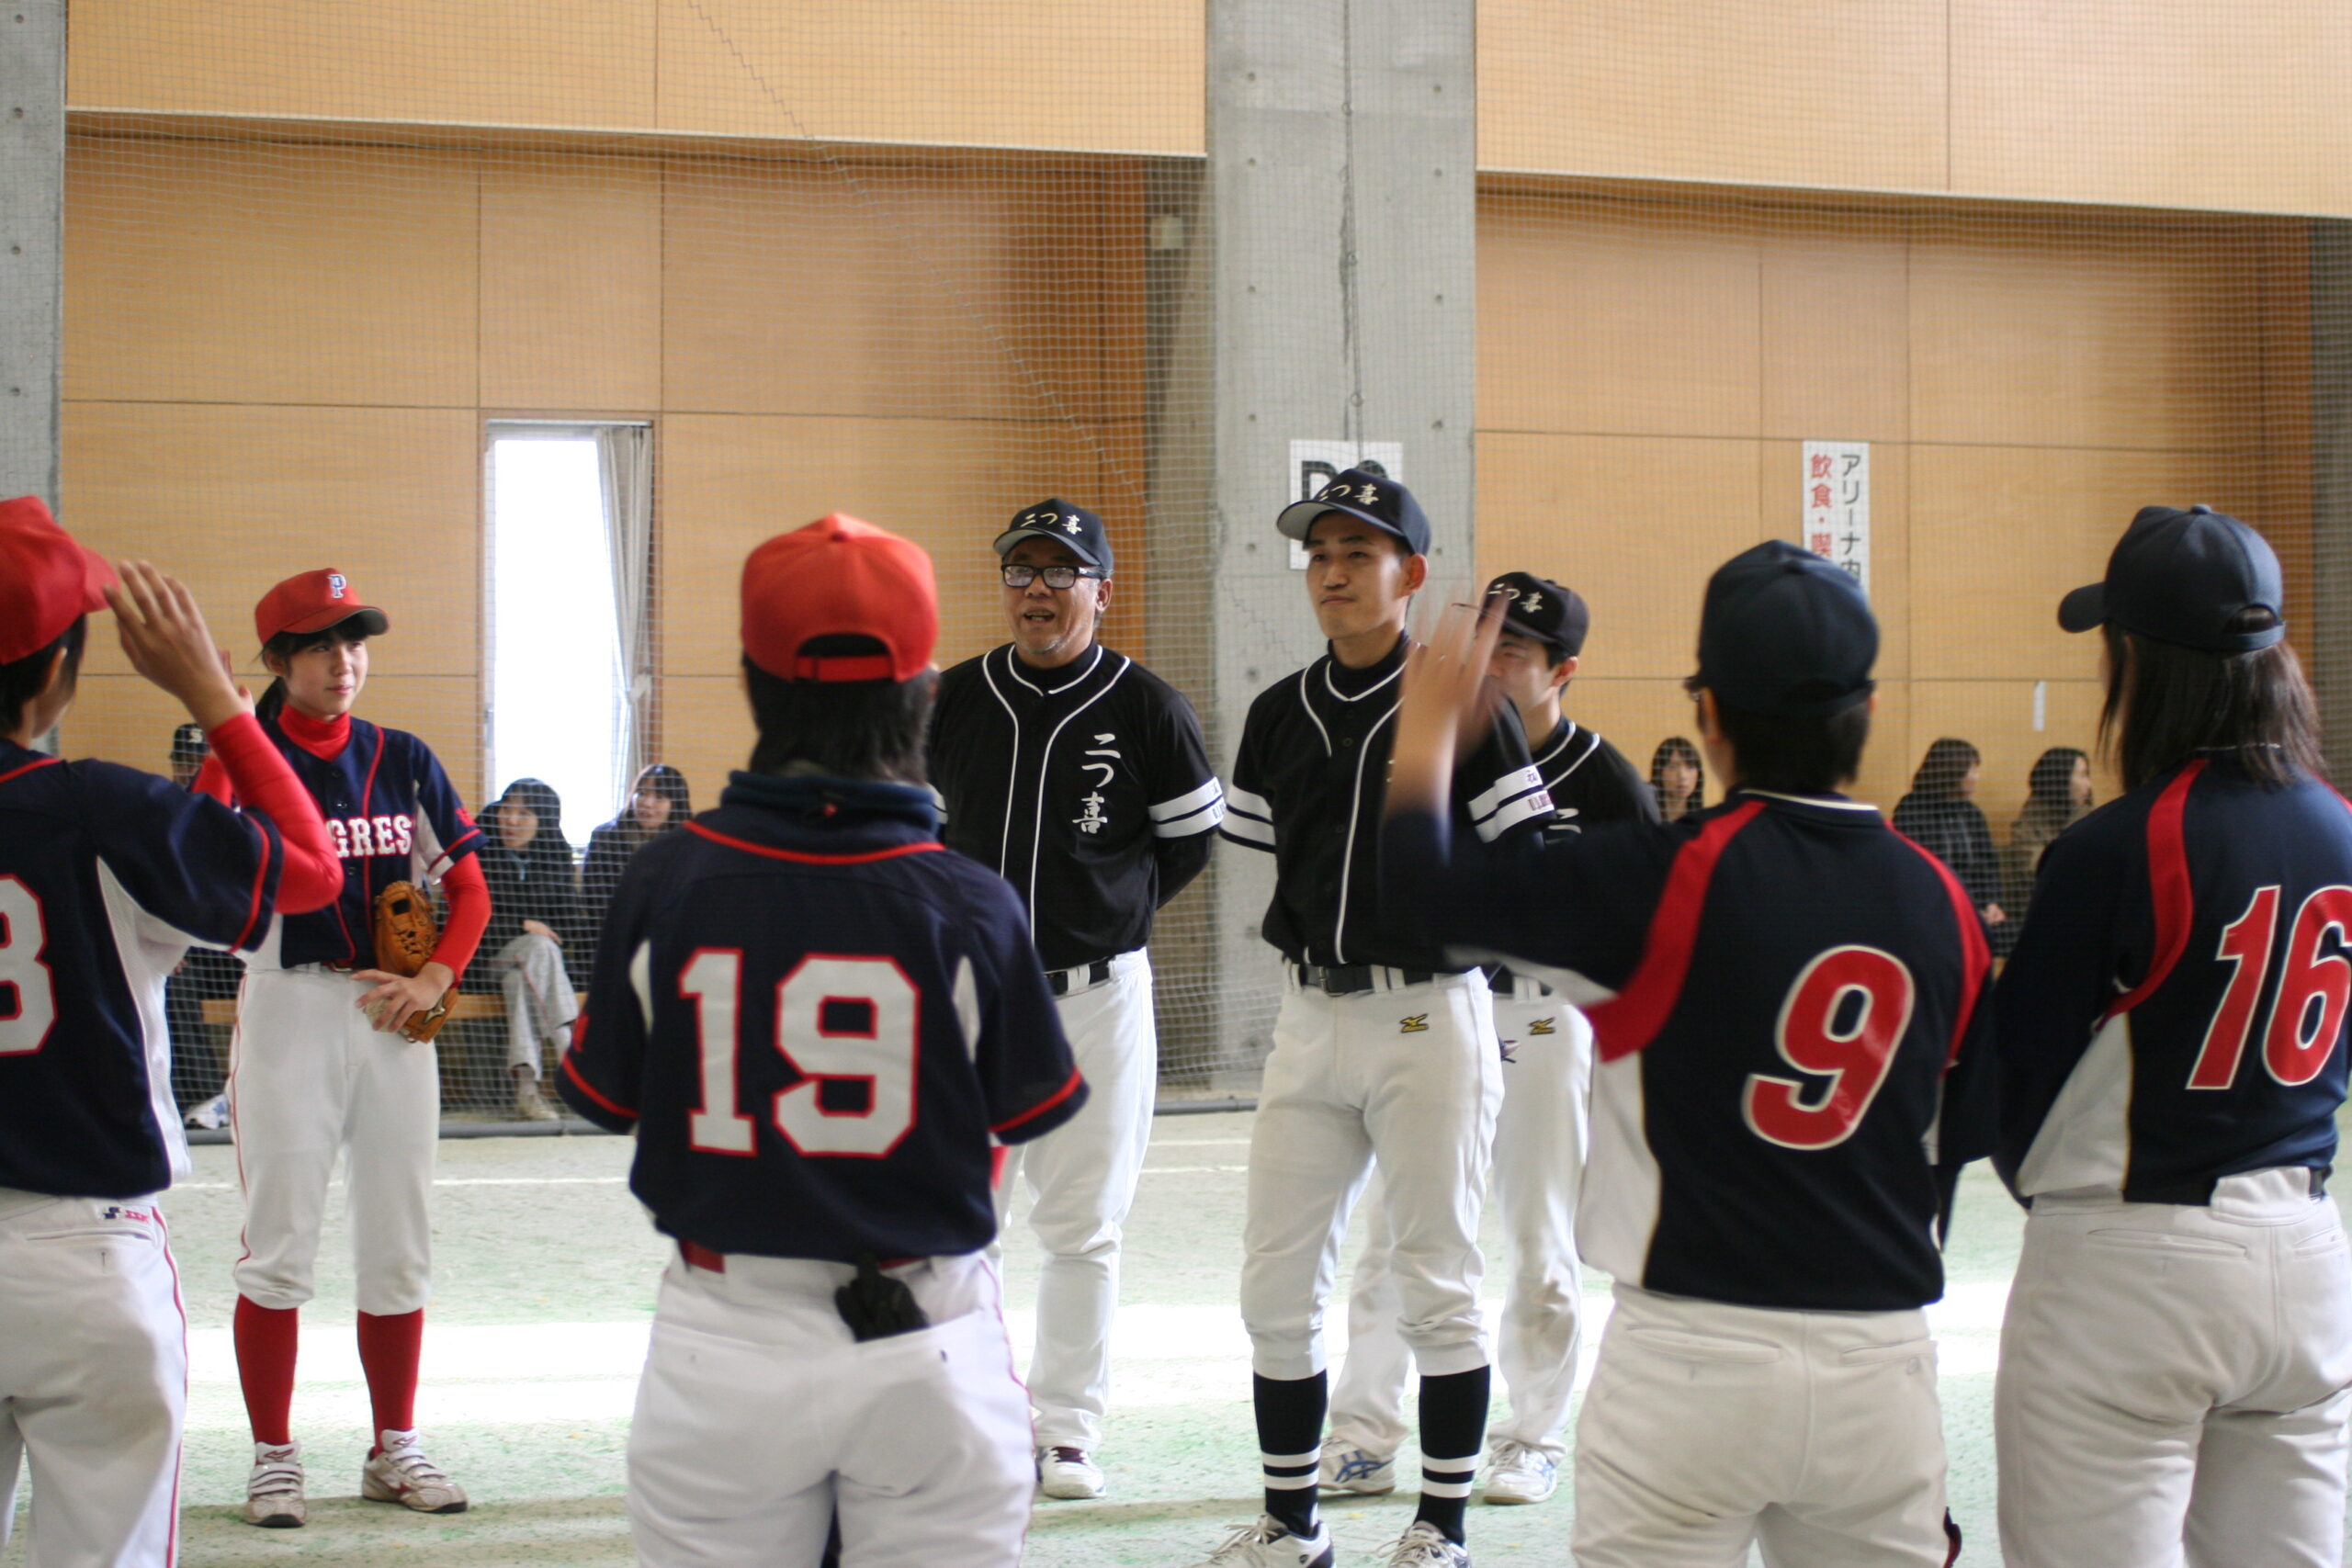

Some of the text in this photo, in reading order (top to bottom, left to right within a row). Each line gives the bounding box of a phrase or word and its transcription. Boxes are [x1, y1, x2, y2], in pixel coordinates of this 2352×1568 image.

[327, 573, 347, 599] P
[1020, 513, 1082, 535] 二つ喜
[1072, 733, 1122, 835] 二つ喜
[677, 946, 922, 1160] 19
[1741, 944, 1915, 1151] 9
[2185, 885, 2352, 1090] 16
